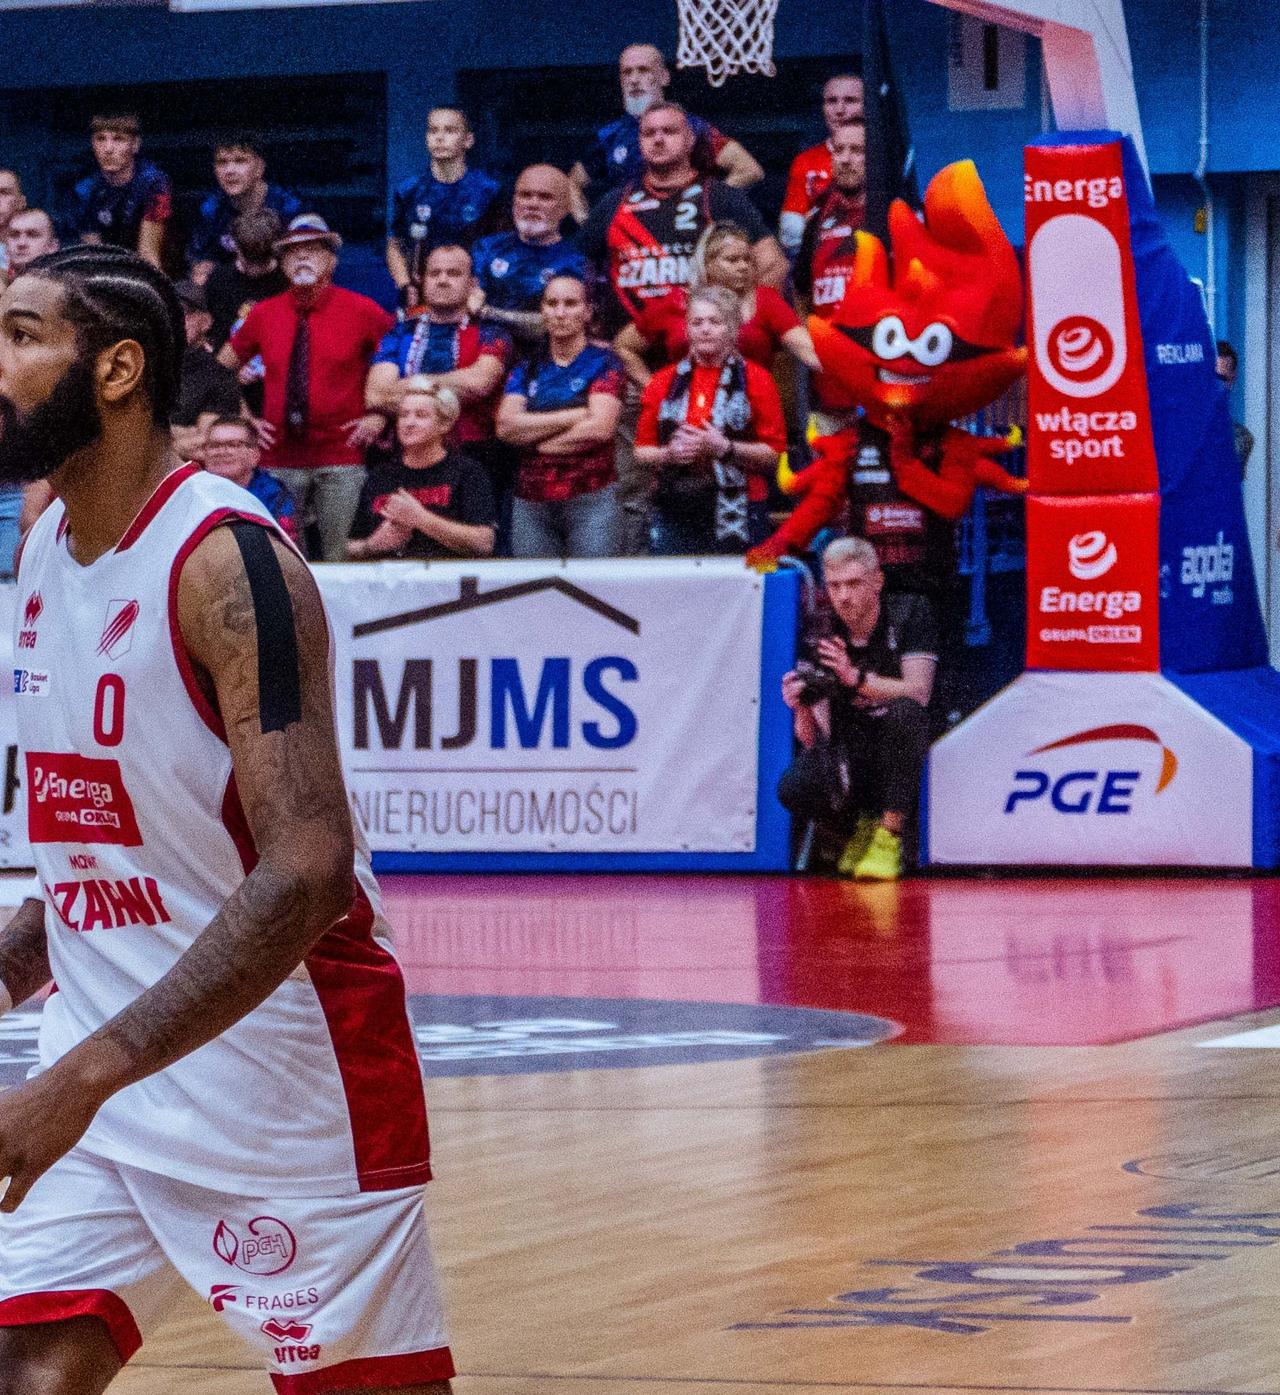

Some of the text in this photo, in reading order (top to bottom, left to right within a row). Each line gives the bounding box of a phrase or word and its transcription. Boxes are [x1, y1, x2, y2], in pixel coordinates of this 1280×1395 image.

[674, 202, 698, 230] 2
[1035, 406, 1137, 437] włącza
[1050, 434, 1125, 466] sport
[1040, 586, 1141, 619] Energa
[93, 673, 126, 747] 0
[352, 655, 639, 750] MJMS
[351, 782, 638, 836] NIERUCHOMOŚCI
[1004, 770, 1141, 815] PGE
[246, 1287, 319, 1310] FRAGES
